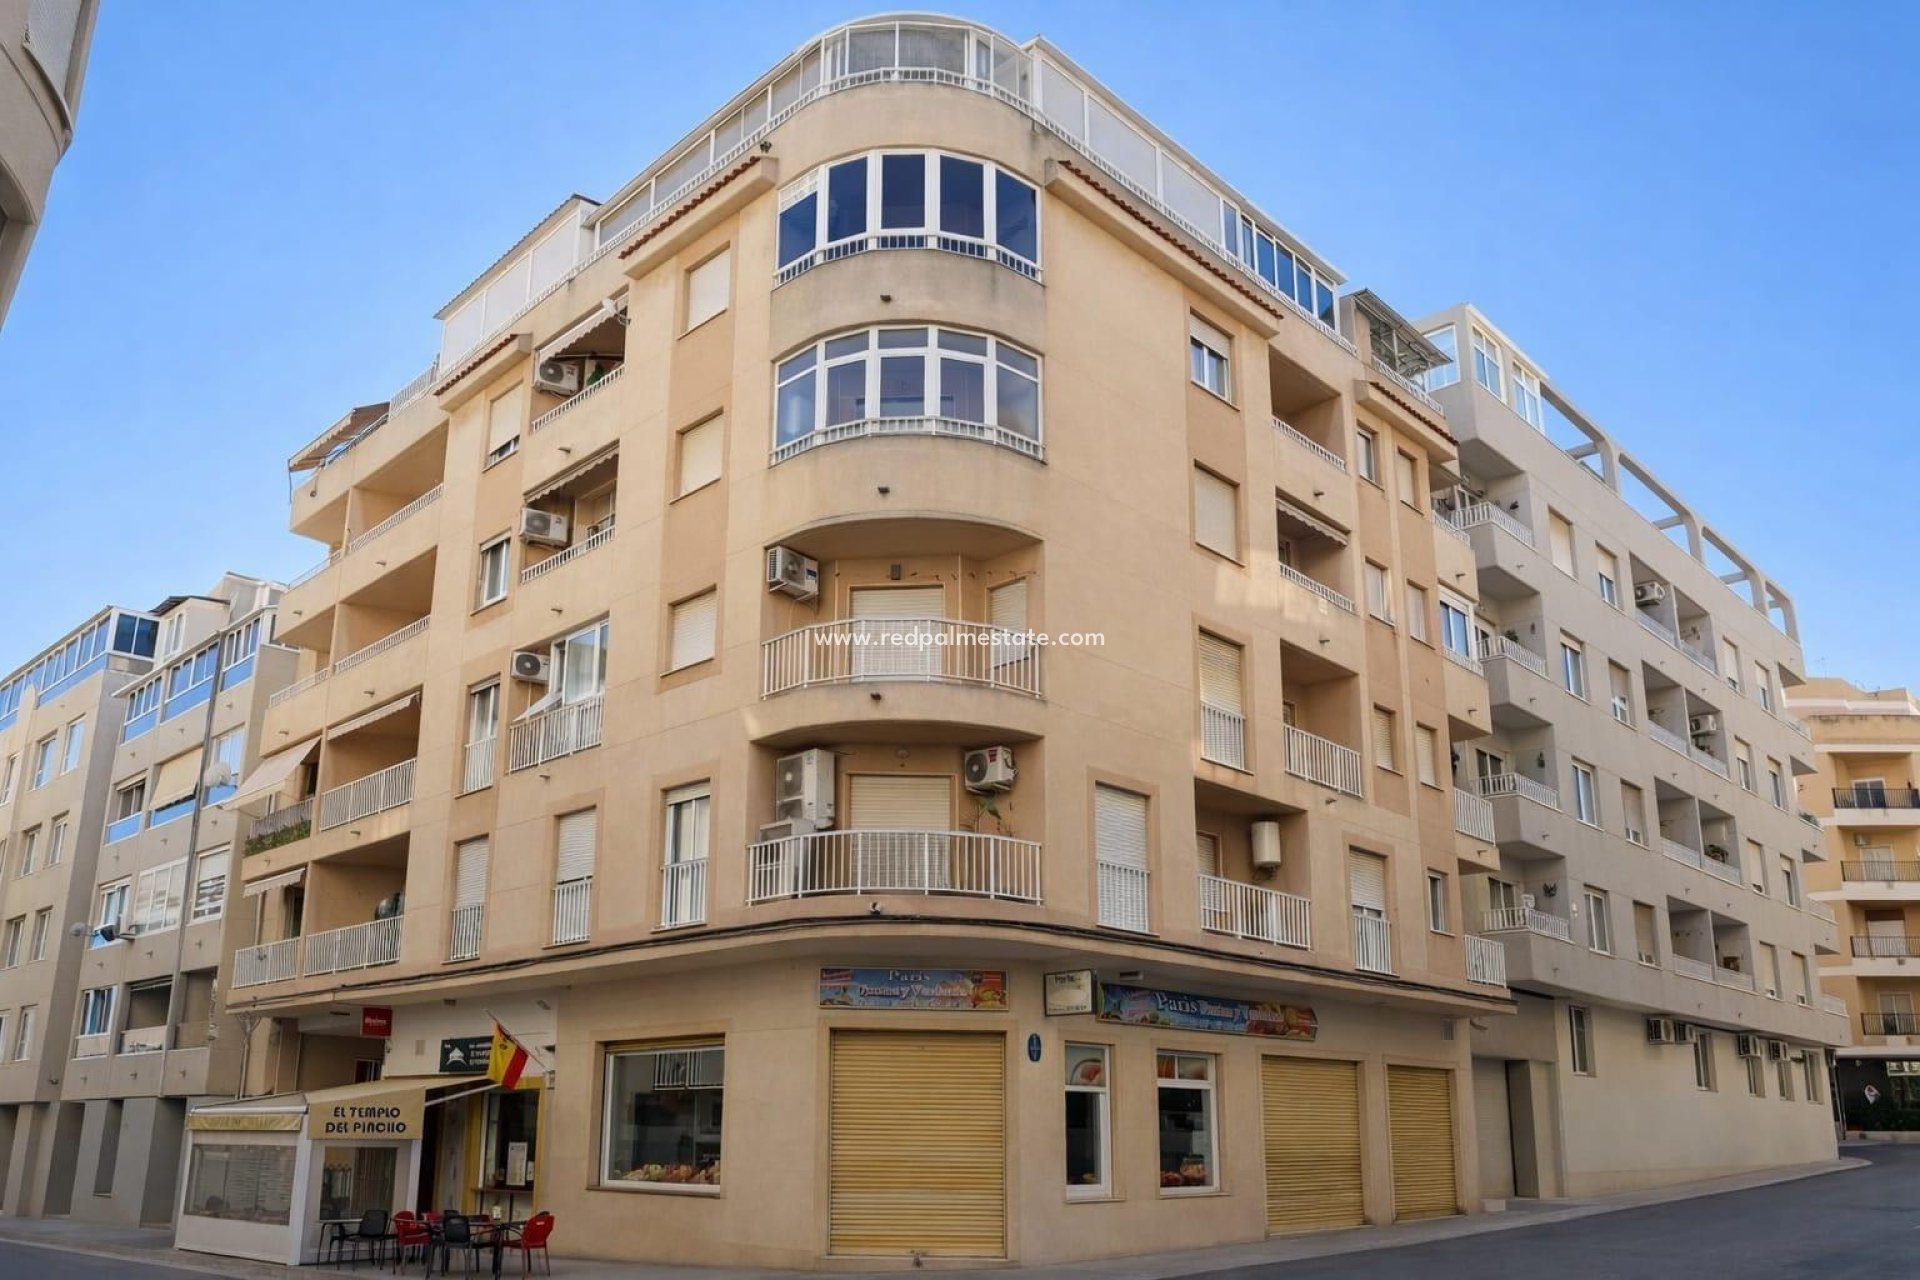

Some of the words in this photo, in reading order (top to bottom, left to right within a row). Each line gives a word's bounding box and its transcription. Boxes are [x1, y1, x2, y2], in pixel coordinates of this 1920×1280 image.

[1155, 991, 1198, 1013] Paris
[333, 1106, 346, 1118] EL
[350, 1106, 401, 1118] TEMPLO
[325, 1121, 349, 1133] DEL
